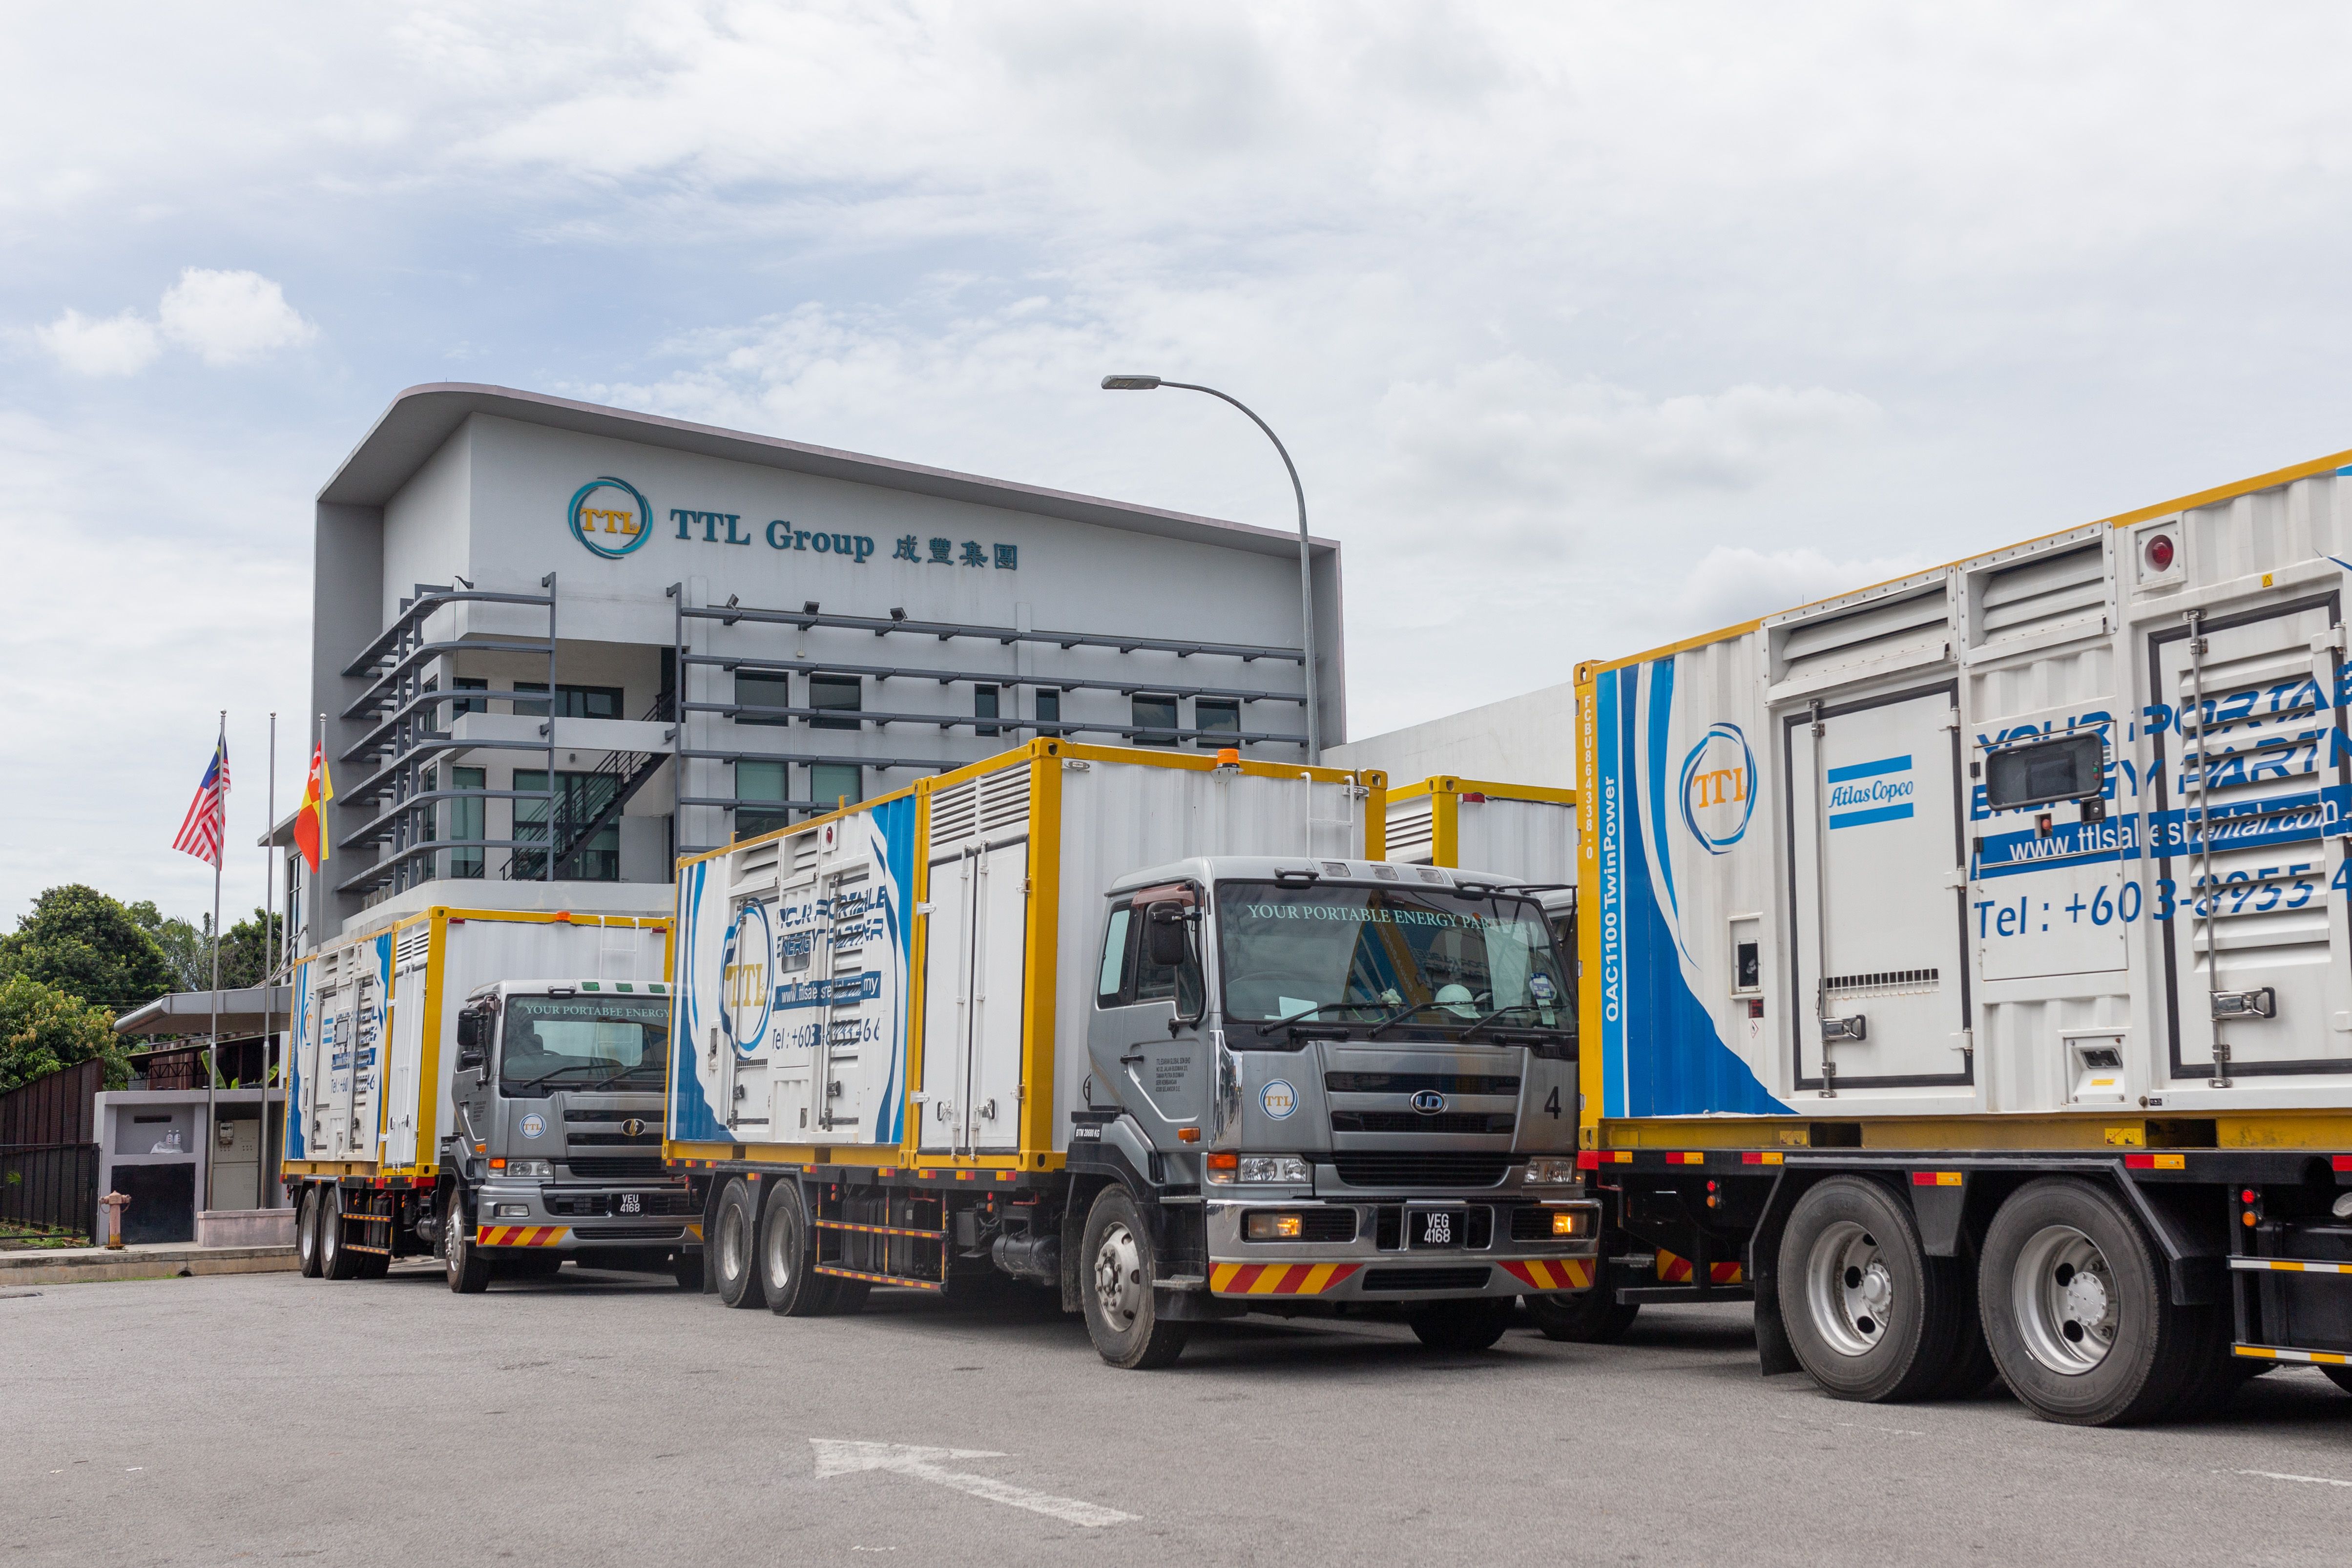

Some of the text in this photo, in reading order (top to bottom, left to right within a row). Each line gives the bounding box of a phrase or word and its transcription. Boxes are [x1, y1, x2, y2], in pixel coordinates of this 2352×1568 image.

[580, 507, 641, 535] TTL
[670, 509, 874, 563] TTL Group
[893, 535, 1018, 570] 成豐集團
[1693, 767, 1748, 808] TTL
[1829, 780, 1913, 808] Atlas Copco
[1603, 775, 1619, 1022] QAC1100 TwinPower
[1247, 905, 1300, 919] YOUR
[1304, 906, 1391, 924] PORTABLE
[1393, 910, 1457, 928] ENERGY
[1974, 896, 2027, 939] Tel
[725, 963, 766, 1007] TTL
[526, 1006, 669, 1017] YOUR PORTABLE ENERGY
[772, 1028, 784, 1049] Tel
[1265, 1096, 1293, 1106] TTL
[1415, 1095, 1442, 1109] UD
[1544, 1086, 1561, 1119] 4
[1076, 1129, 1084, 1137] BTM
[1094, 1129, 1100, 1138] KG
[620, 1203, 640, 1213] 4168
[622, 1194, 639, 1203] VEU
[1427, 1213, 1449, 1228] VEG
[1424, 1228, 1451, 1243] 4168
